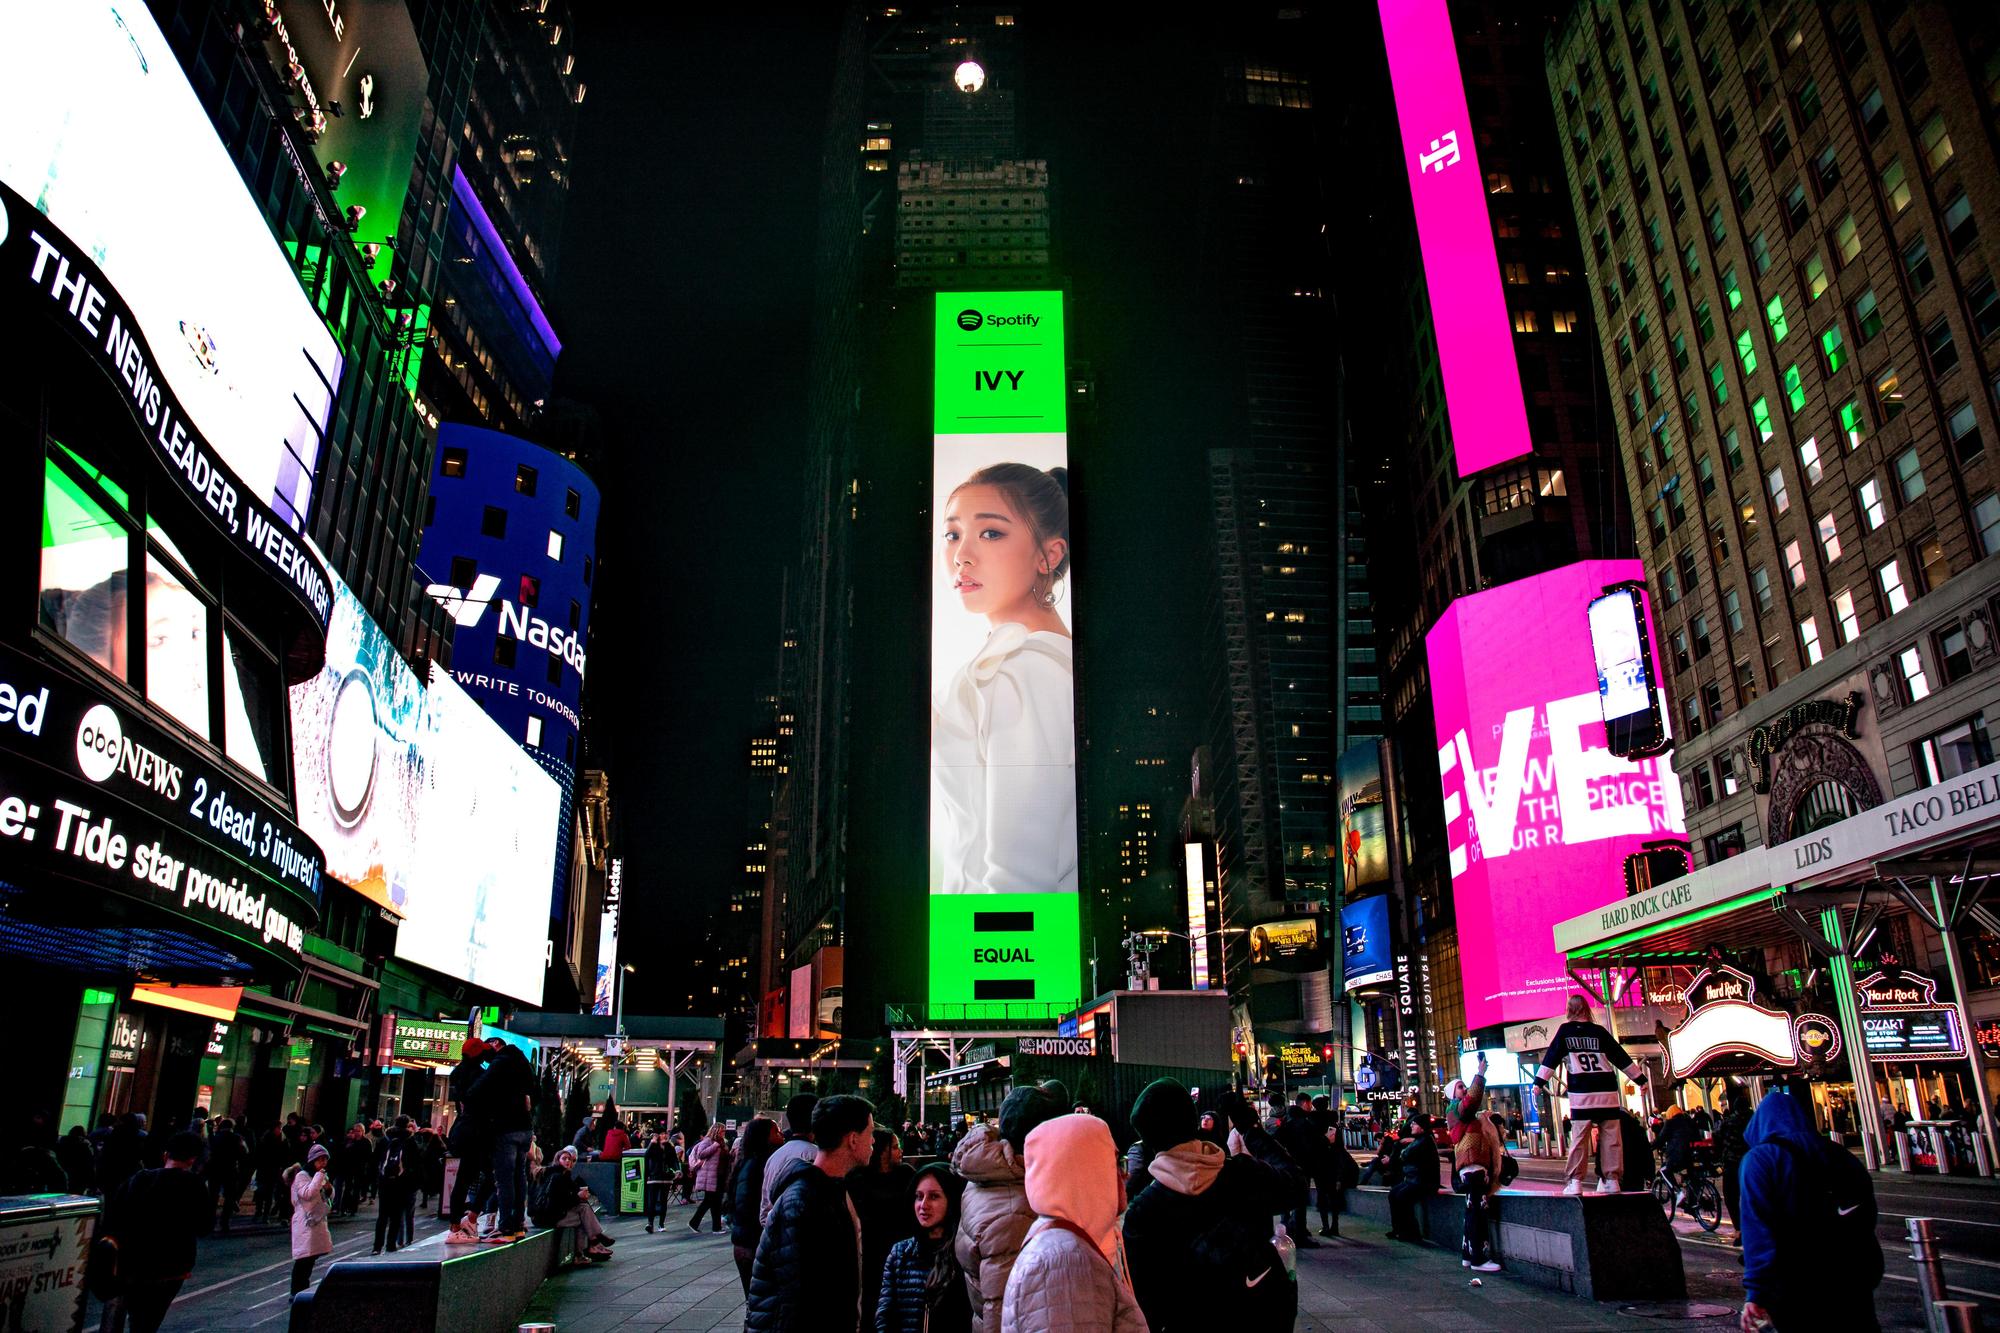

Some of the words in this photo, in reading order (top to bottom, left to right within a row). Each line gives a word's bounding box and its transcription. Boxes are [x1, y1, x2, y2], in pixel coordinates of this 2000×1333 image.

[986, 313, 1041, 328] Spotify
[30, 229, 107, 339] THE
[105, 314, 161, 427] NEWS
[158, 405, 239, 534] LEADER,
[975, 370, 1025, 391] IVY
[498, 599, 587, 688] Nasda
[82, 726, 118, 759] abc
[117, 736, 183, 801] NEWS
[189, 777, 208, 819] 2
[209, 790, 257, 857] dead,
[260, 821, 273, 858] 3
[272, 828, 315, 888] injured
[1884, 796, 1945, 837] TACO
[1793, 836, 1834, 870] LIDS
[54, 799, 128, 870] Tide
[132, 841, 185, 892] star
[183, 867, 267, 930] provided
[263, 907, 289, 944] gun
[607, 858, 622, 900] Locker
[1601, 908, 1629, 931] HARD
[1631, 896, 1661, 922] ROCK
[1662, 883, 1693, 909] CAFE
[1292, 934, 1308, 943] Mala
[974, 948, 1035, 963] EQUAL
[1376, 971, 1392, 981] CHAS
[1397, 955, 1413, 1015] SQUARE
[1525, 977, 1555, 987] Exclusions
[1706, 983, 1725, 1000] Hard
[1725, 980, 1744, 999] Rock
[1867, 989, 1893, 1001] Hard
[1894, 988, 1919, 1002] Rock
[395, 1025, 467, 1041] STARBUCKS
[403, 1039, 450, 1053] COFFEE
[1036, 1039, 1091, 1056] HOTDOGS
[1403, 1029, 1417, 1076] TIMES
[1463, 1037, 1478, 1051] AT&T
[1304, 1053, 1321, 1063] Mala
[1577, 1053, 1603, 1072] 92
[1367, 1092, 1402, 1101] CHASE
[1408, 1085, 1420, 1094] 3
[33, 1266, 76, 1295] STYLE
